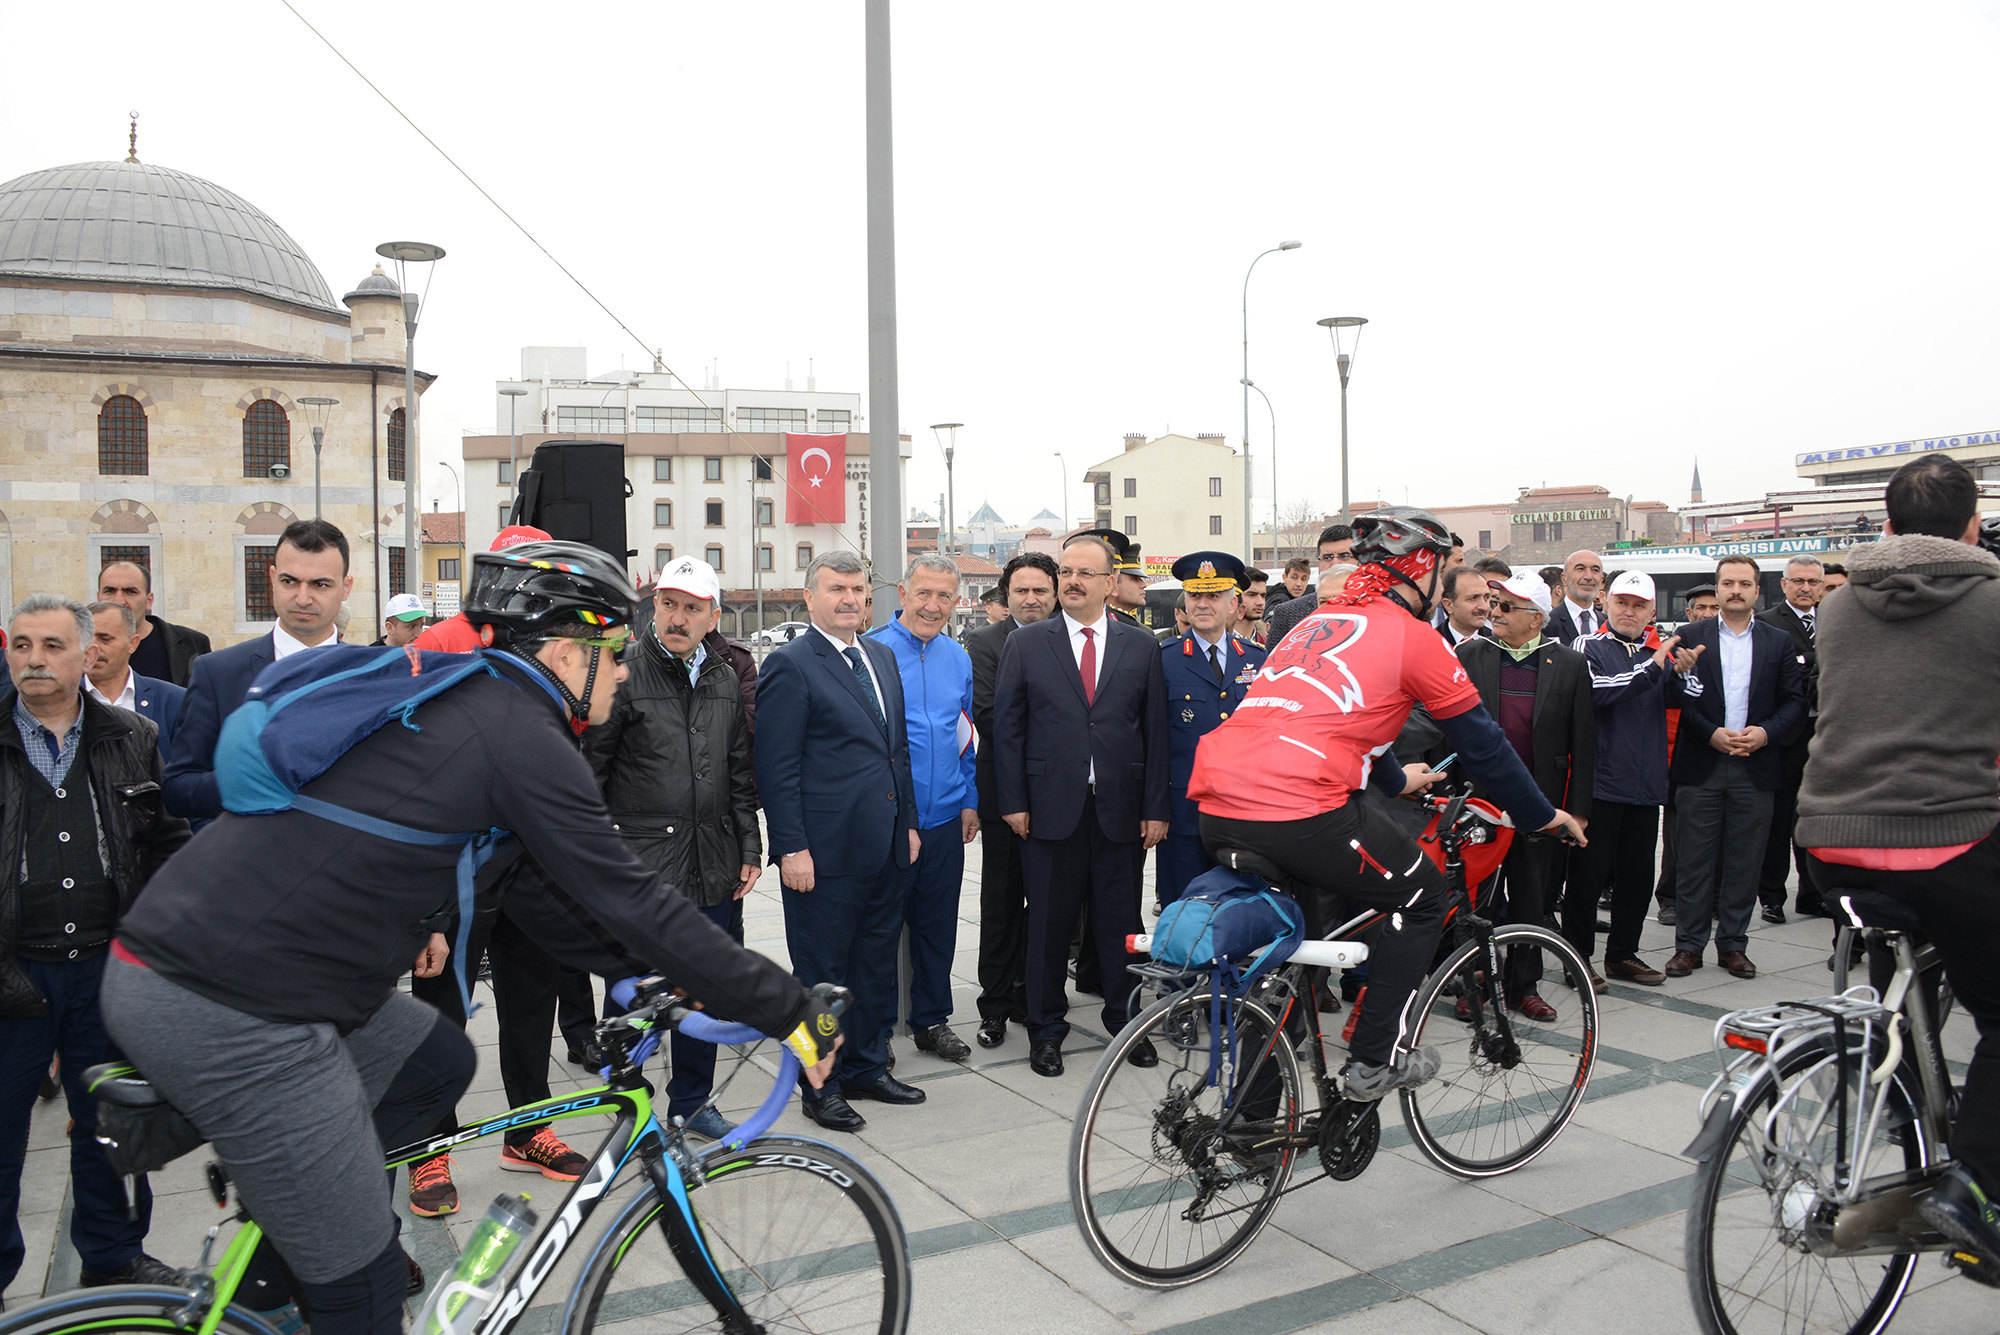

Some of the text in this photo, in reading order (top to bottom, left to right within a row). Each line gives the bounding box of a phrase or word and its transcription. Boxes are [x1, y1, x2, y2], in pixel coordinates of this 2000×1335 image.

[1802, 443, 1912, 463] MERVE
[1924, 437, 1960, 450] HAC
[845, 471, 871, 480] HOT
[1513, 513, 1550, 523] CEYLAN
[1779, 539, 1821, 551] AVM
